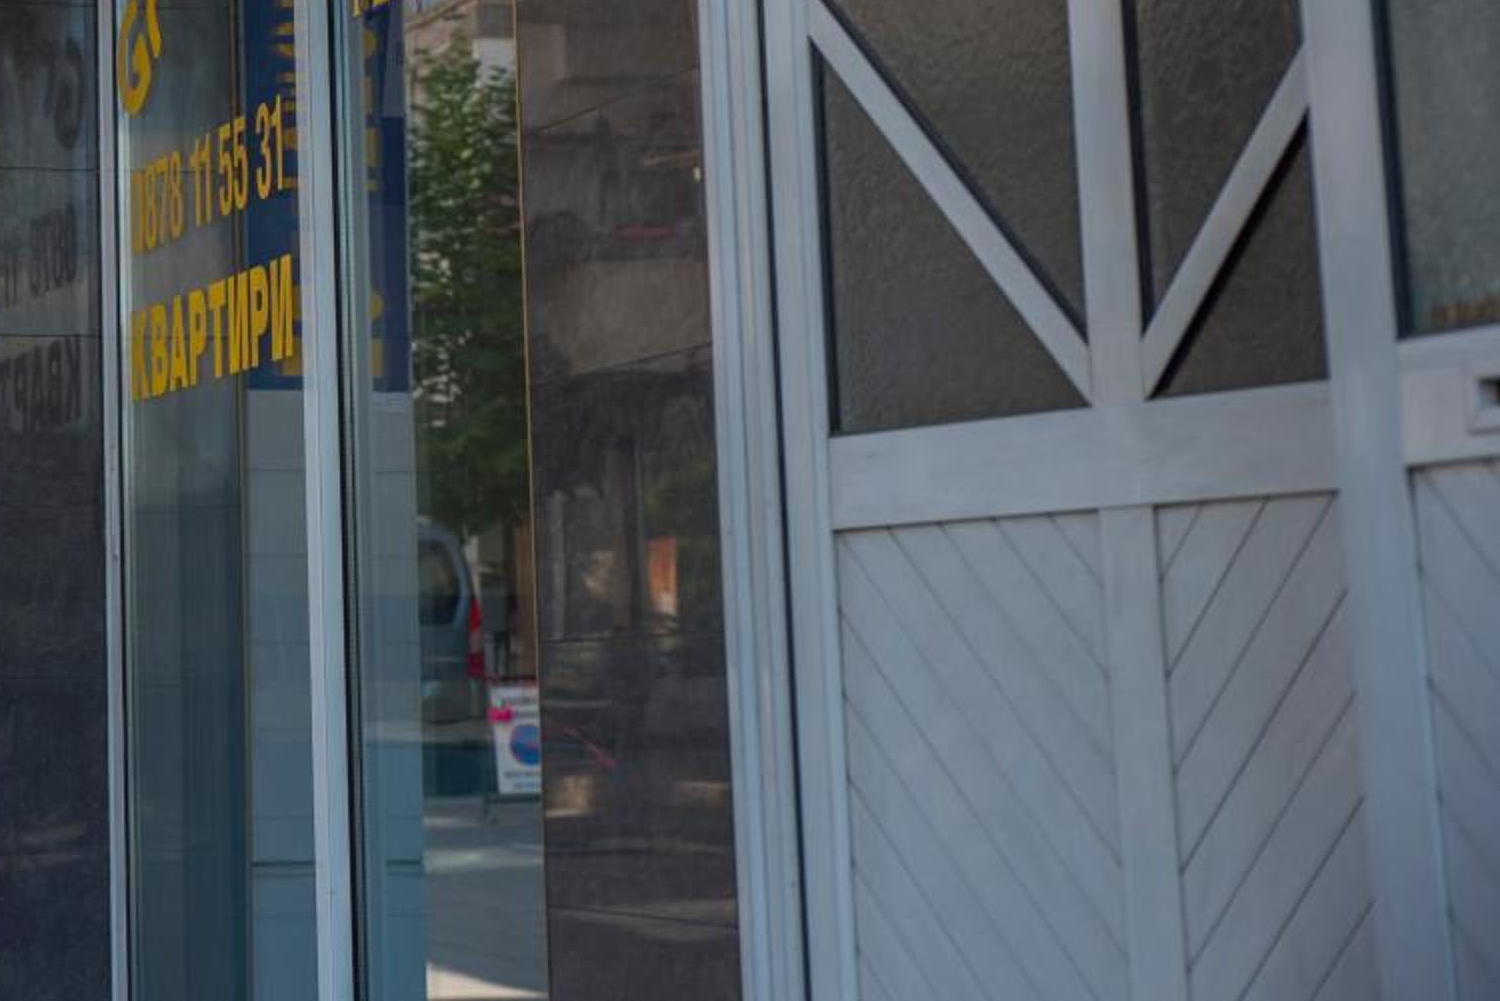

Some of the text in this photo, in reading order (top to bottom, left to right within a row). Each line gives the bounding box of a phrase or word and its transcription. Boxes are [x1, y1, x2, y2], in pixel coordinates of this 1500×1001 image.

[189, 132, 213, 228] 11
[218, 114, 249, 216] 55
[256, 93, 284, 200] 31
[131, 253, 294, 404] КВАРТИРИ
